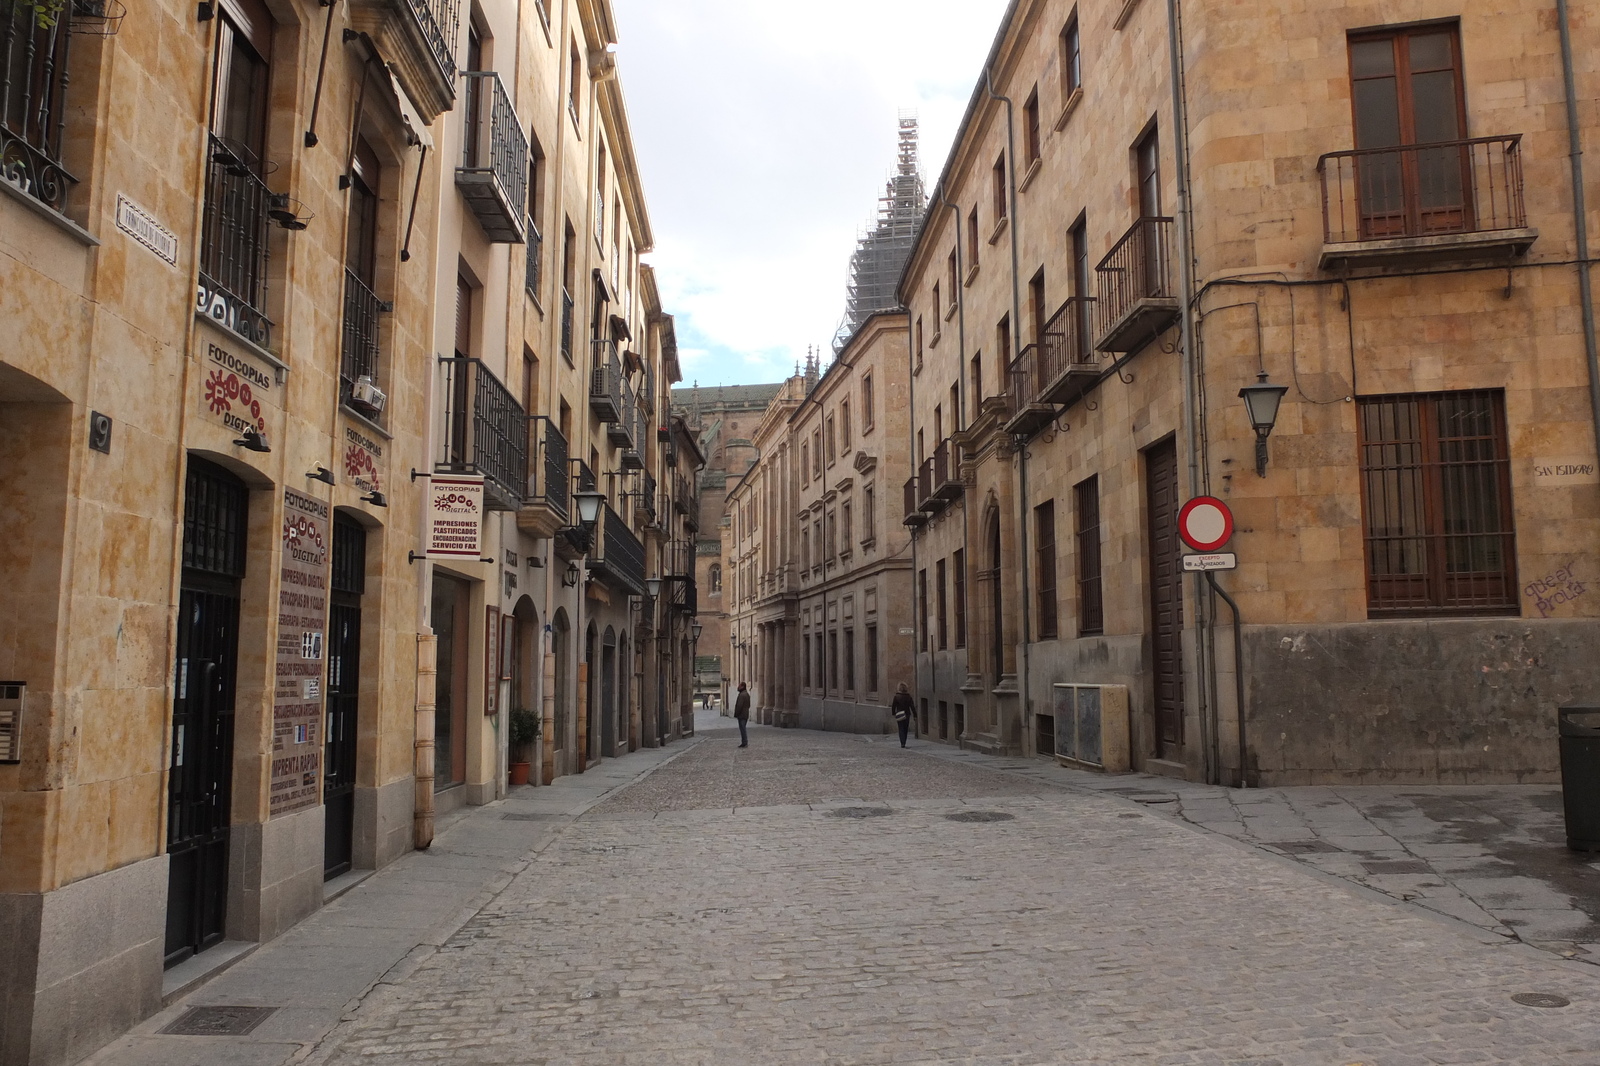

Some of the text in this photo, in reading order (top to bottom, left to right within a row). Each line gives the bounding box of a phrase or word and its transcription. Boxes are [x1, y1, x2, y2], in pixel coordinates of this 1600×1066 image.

[208, 343, 270, 388] FOTOCOPIAS
[96, 416, 108, 447] 9
[347, 427, 382, 456] FOTOCOPIAS
[1534, 464, 1594, 477] SAN ISIDORO
[284, 491, 328, 519] FOTOCOPIAS
[433, 527, 477, 535] PLASTIFICADOS
[293, 548, 322, 565] DIGITAL
[1524, 560, 1574, 601] queer
